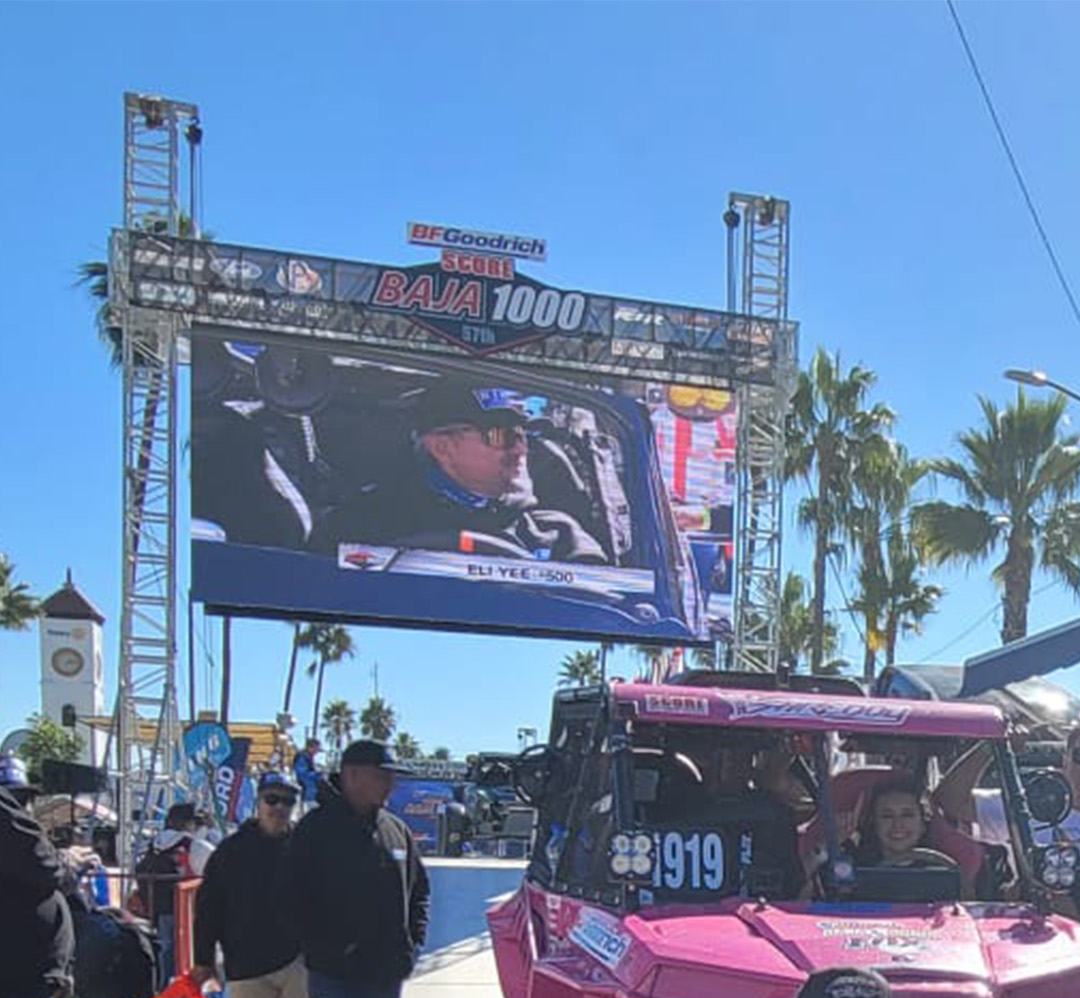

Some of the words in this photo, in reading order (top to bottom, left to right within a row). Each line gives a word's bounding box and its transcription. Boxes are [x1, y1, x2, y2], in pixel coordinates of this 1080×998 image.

[411, 223, 545, 255] BFGoodrich
[440, 250, 515, 280] SCORE
[374, 271, 483, 318] BAJA
[491, 284, 585, 331] 1000
[467, 563, 494, 577] ELI
[499, 567, 531, 581] YEE
